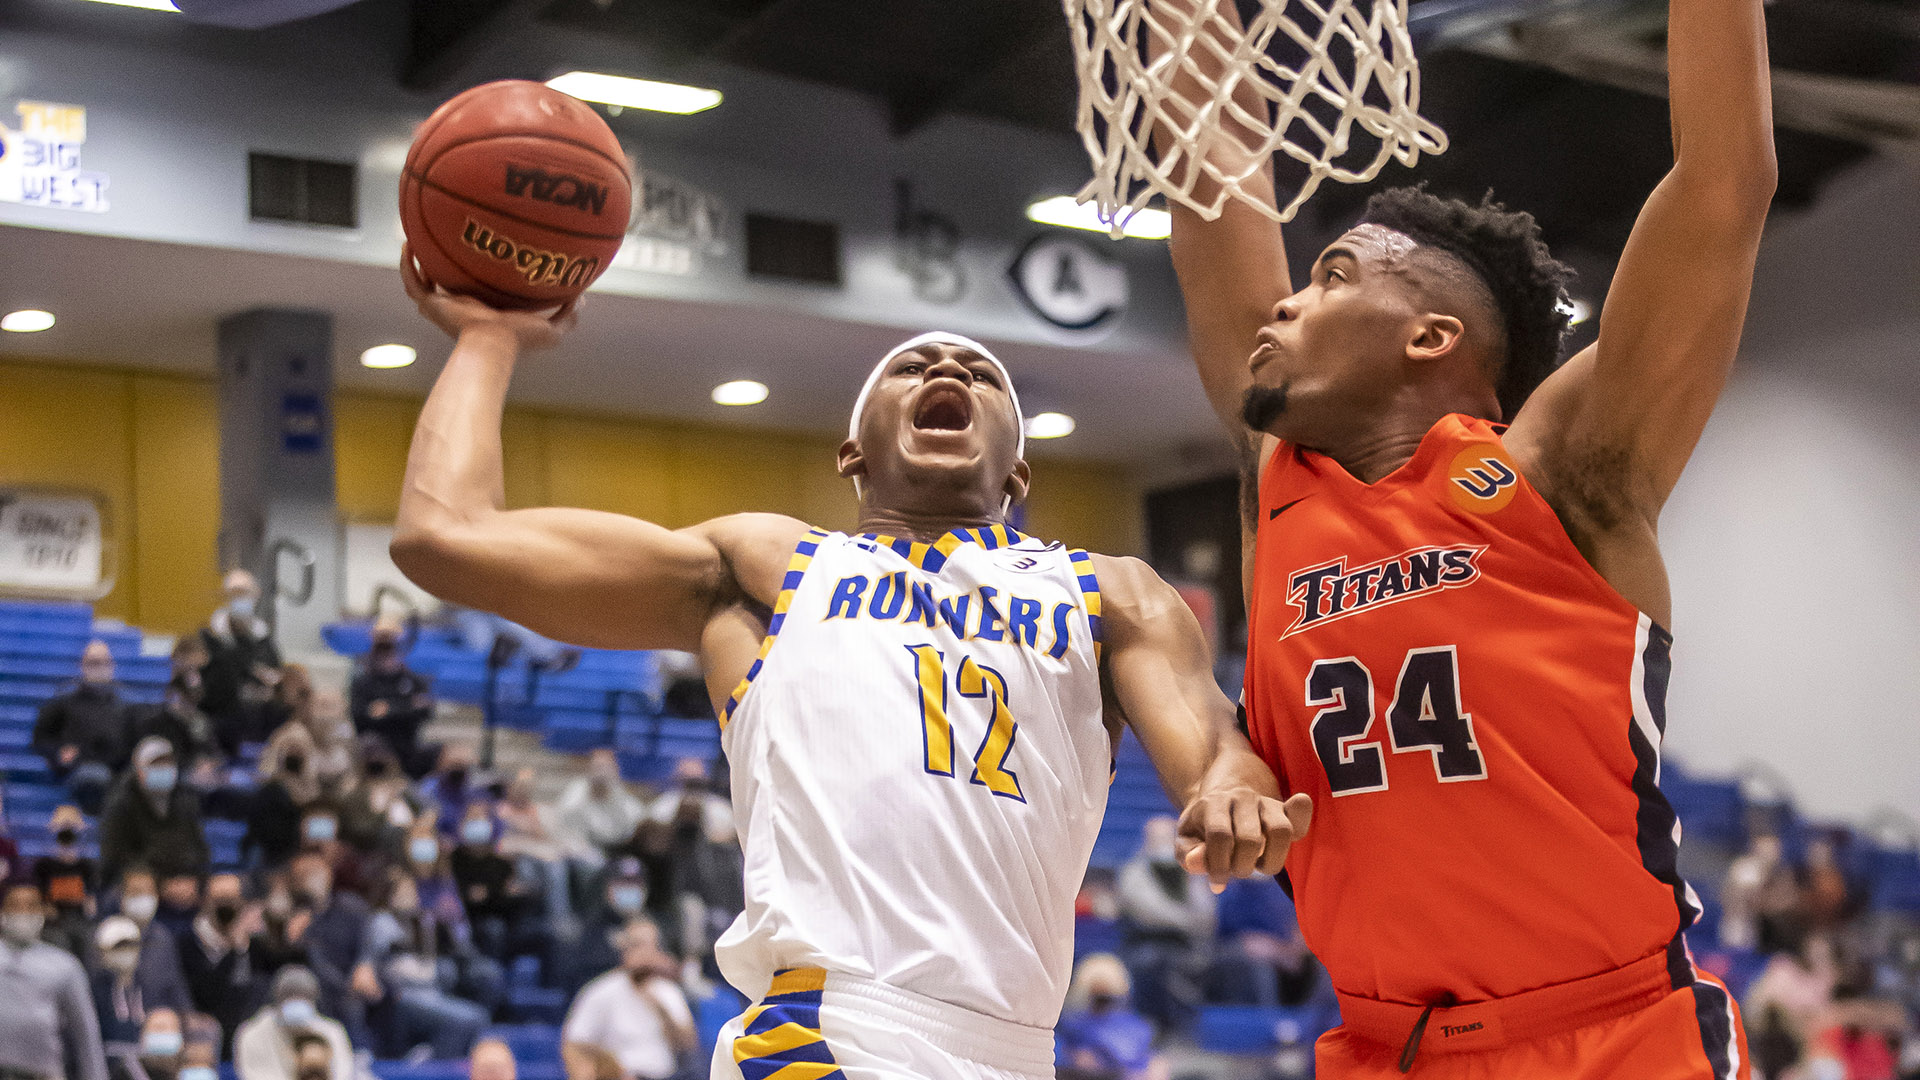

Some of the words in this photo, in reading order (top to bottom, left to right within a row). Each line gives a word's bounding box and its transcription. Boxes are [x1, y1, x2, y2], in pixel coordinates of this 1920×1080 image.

[21, 170, 110, 212] WEST
[505, 166, 608, 215] NCAA
[461, 215, 600, 287] Wilson
[820, 571, 1080, 661] RUNNERS
[1284, 546, 1484, 632] TITANS
[903, 643, 1028, 805] 12
[1304, 644, 1488, 797] 24
[1440, 1021, 1484, 1038] TITANS
